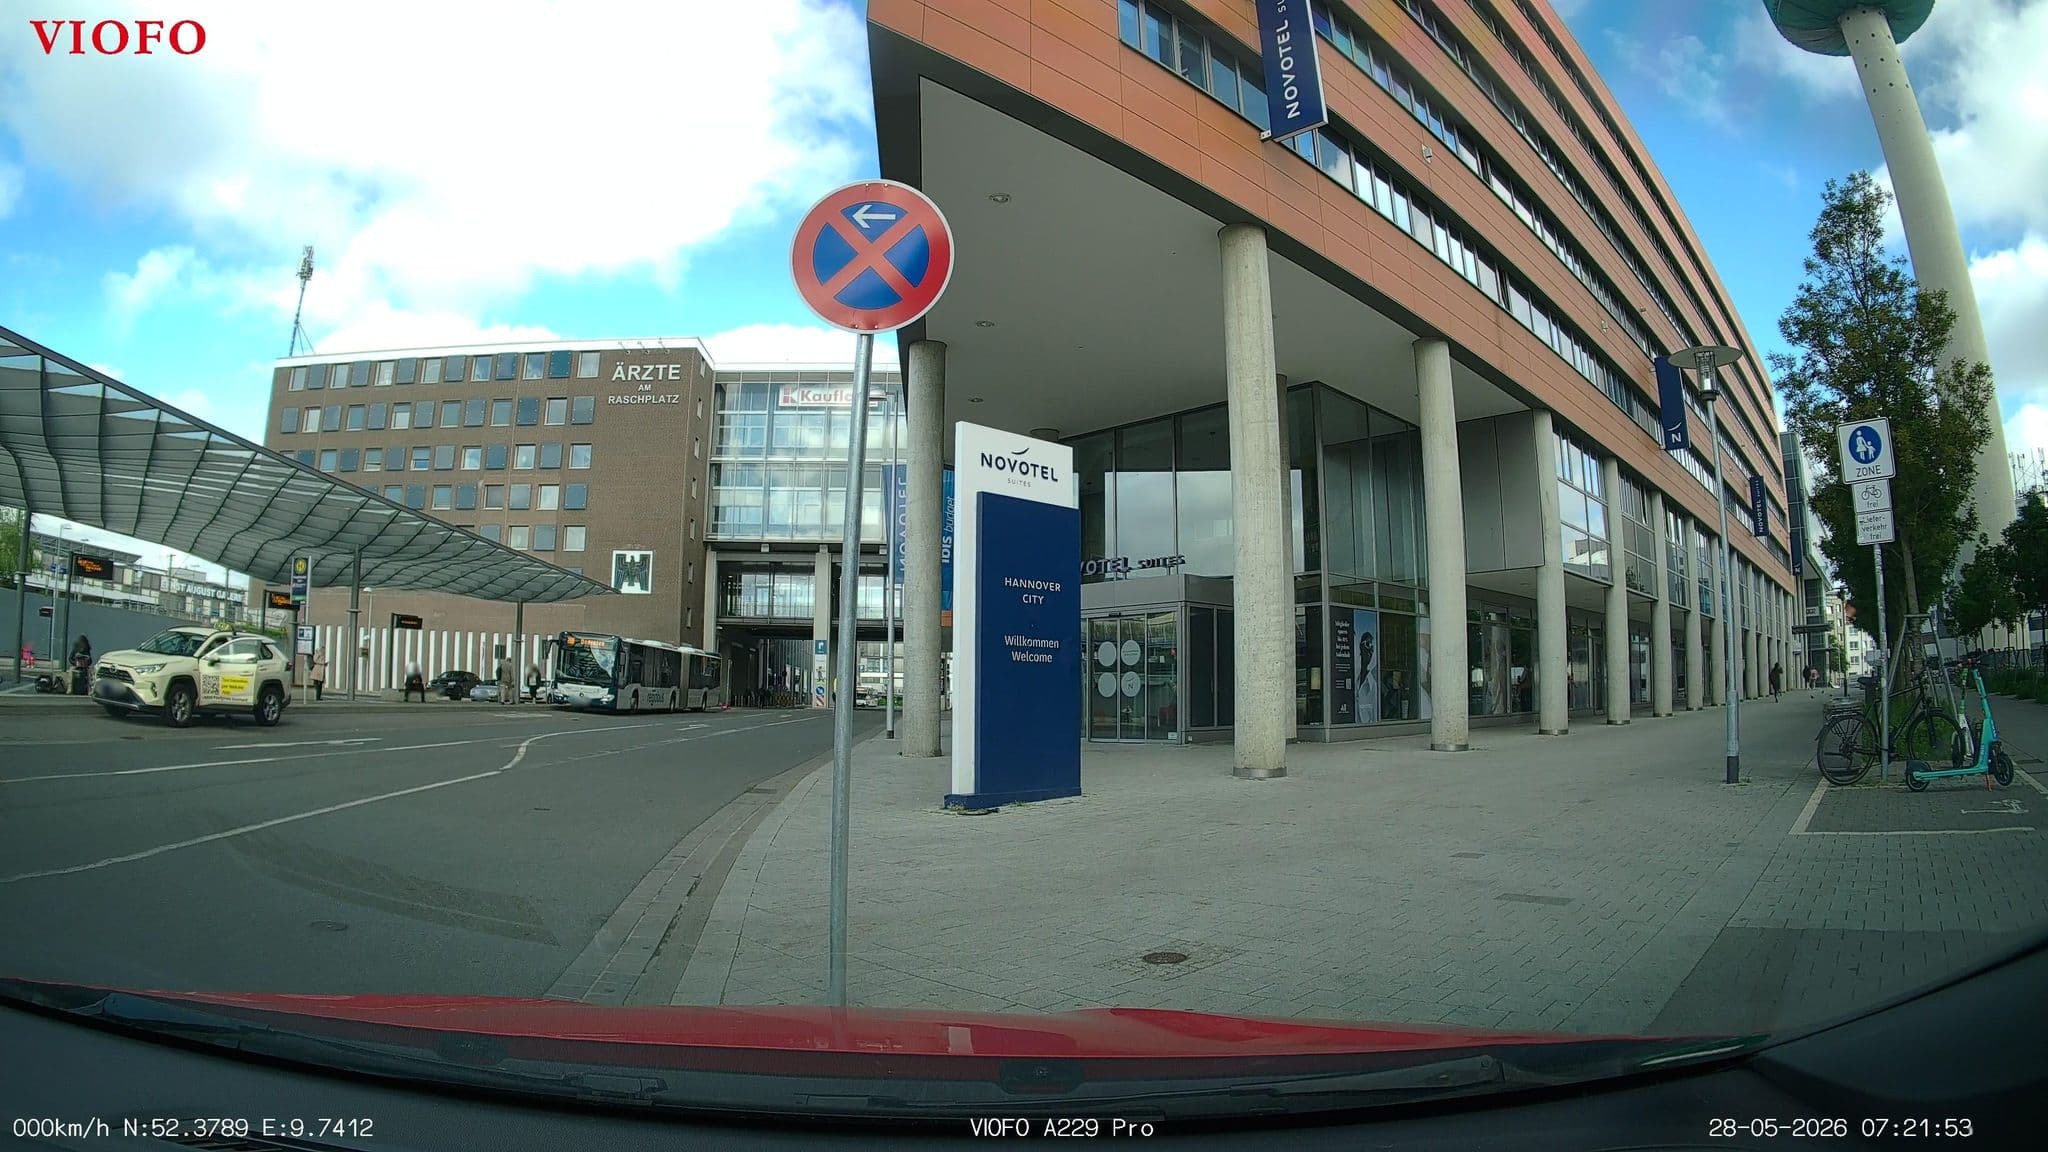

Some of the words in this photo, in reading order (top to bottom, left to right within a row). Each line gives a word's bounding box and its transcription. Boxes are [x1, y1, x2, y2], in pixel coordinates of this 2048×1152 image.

[1275, 20, 1300, 119] NOVOTEL
[611, 361, 681, 381] ÄRZTE
[638, 384, 652, 392] AM
[608, 395, 680, 404] RASCHPLATZ
[1671, 432, 1682, 444] N
[981, 452, 1058, 482] NOVOTEL
[1856, 464, 1882, 477] ZONE
[1007, 478, 1032, 488] SUITES
[1756, 499, 1764, 533] NOVOTEL
[1861, 523, 1888, 532] verkehr
[1870, 532, 1882, 540] frei
[186, 583, 216, 597] AUGUST
[1004, 577, 1061, 592] HANNOVER
[1022, 594, 1044, 605] CITY
[1004, 634, 1059, 649] Willkommen
[1011, 650, 1053, 663] Welcome
